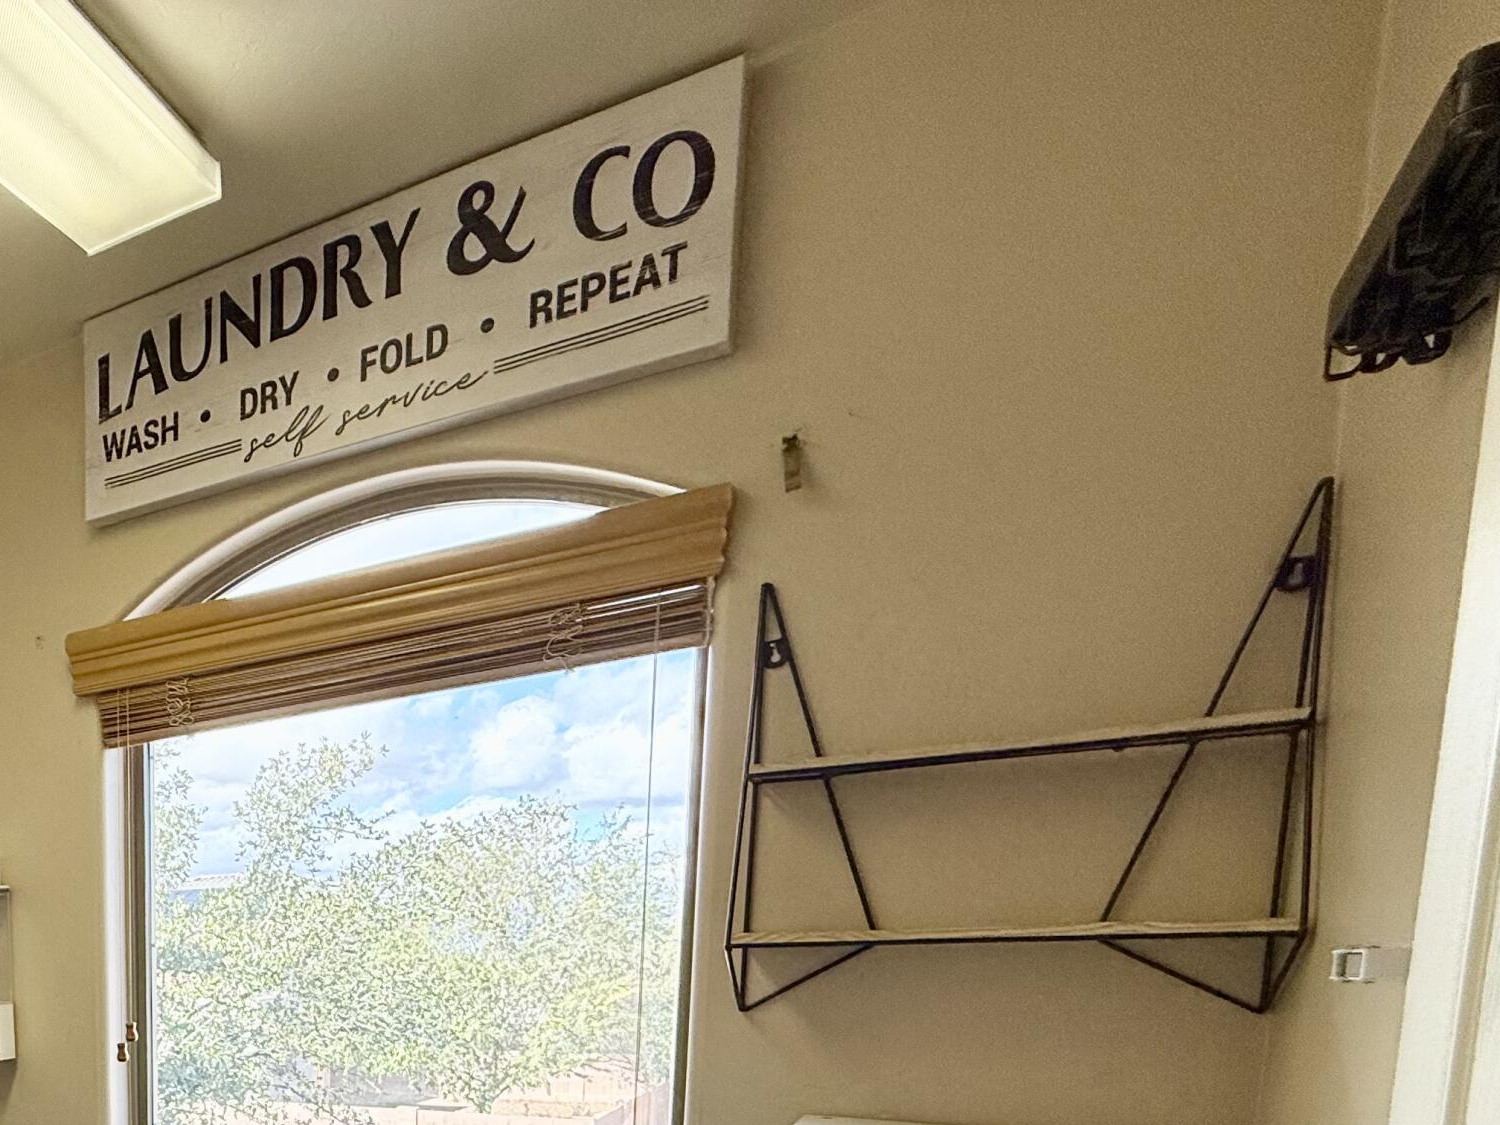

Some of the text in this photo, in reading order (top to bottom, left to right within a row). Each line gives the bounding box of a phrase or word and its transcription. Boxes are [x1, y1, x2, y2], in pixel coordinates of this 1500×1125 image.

[96, 129, 717, 424] LAUNDRY & CO
[101, 241, 689, 463] WASH DRY FOLD REPEAT
[243, 370, 490, 463] self service
